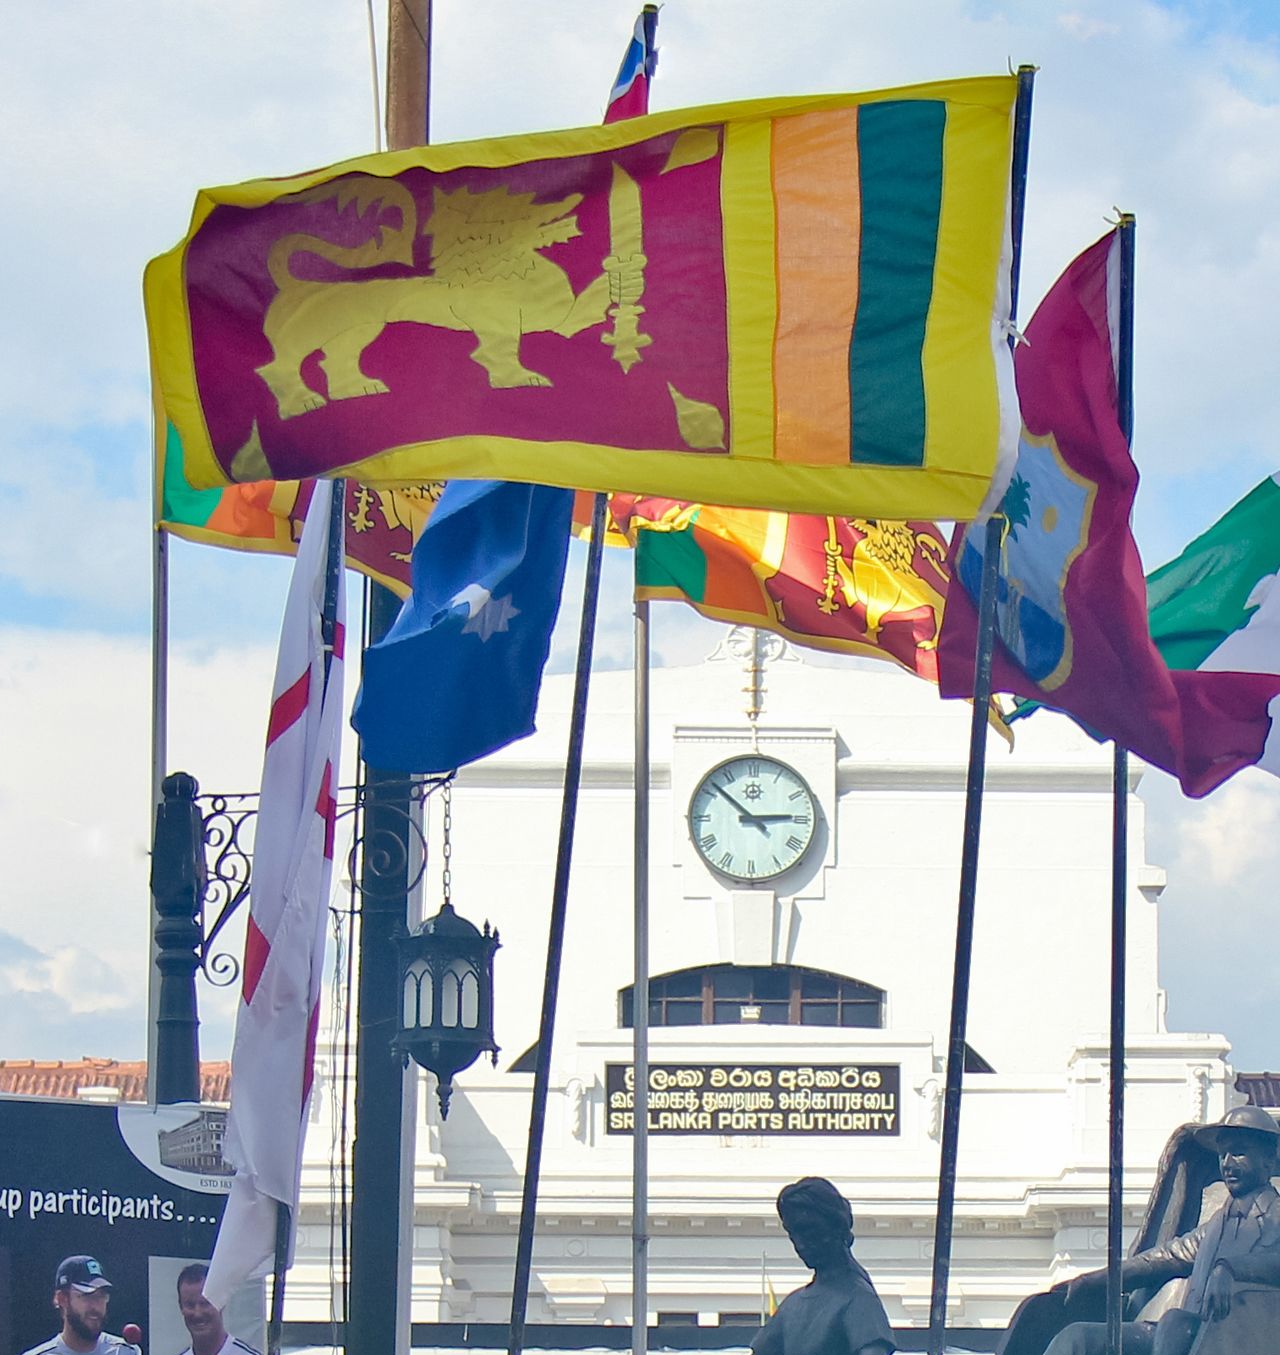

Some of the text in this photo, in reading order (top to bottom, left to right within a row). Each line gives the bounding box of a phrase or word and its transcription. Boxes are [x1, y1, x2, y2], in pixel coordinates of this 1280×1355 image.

[610, 1112, 896, 1130] SR LANKA PORTS AUTHORITY
